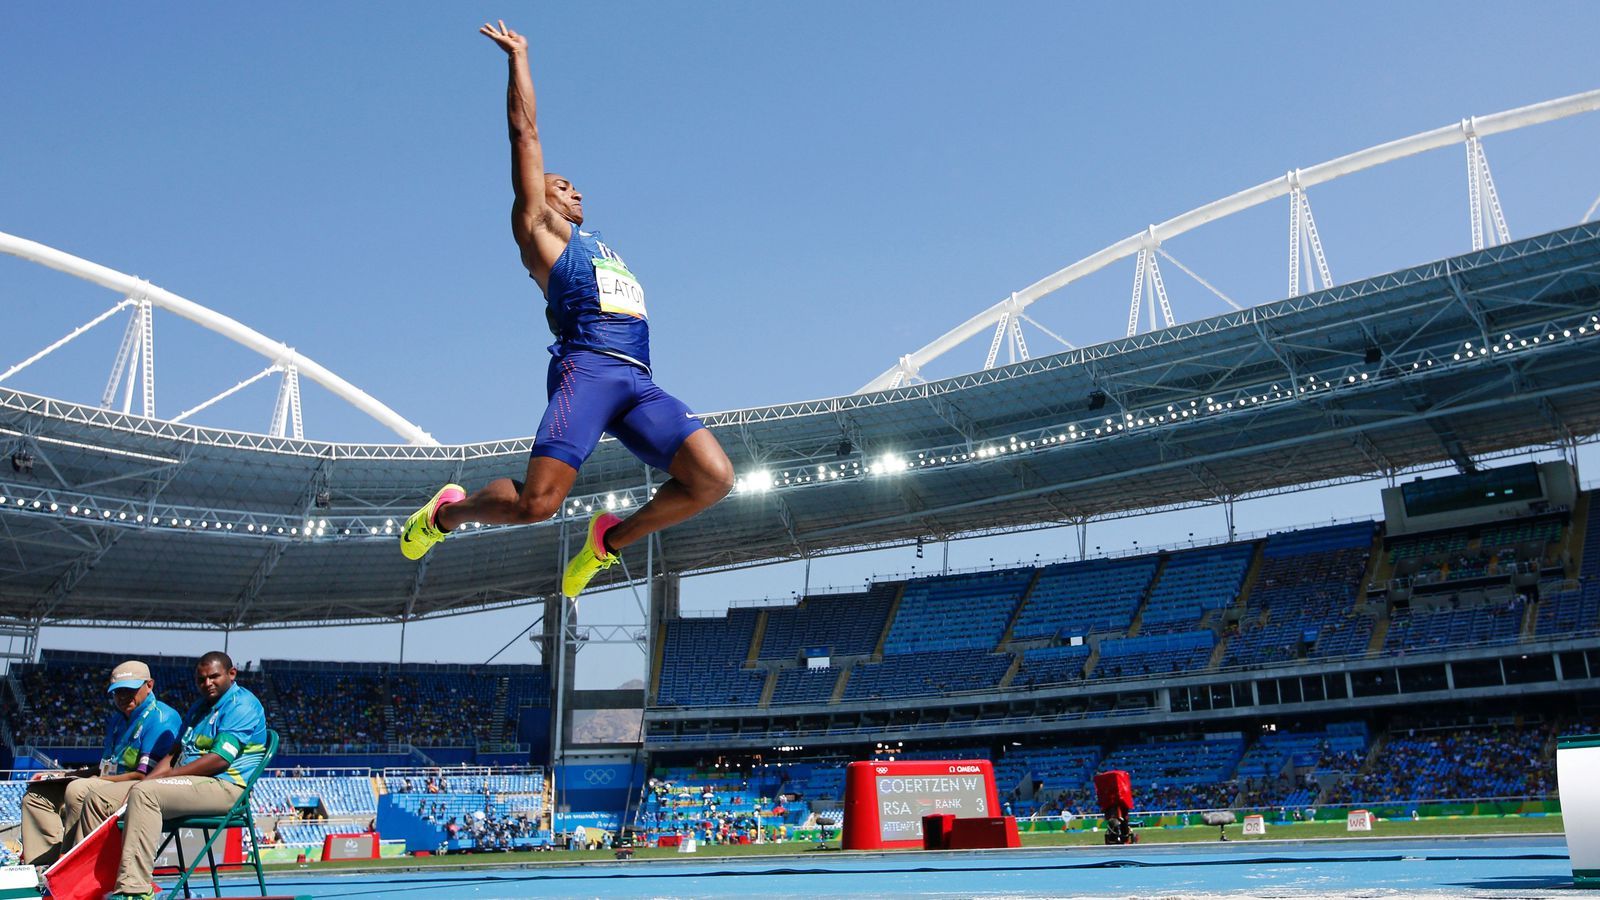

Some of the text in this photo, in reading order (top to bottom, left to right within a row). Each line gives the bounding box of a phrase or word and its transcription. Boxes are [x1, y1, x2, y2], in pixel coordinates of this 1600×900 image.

[879, 777, 977, 794] COERTZEN W
[883, 797, 985, 815] RSA RANK 3
[883, 820, 923, 836] ATTEMPT 1
[1246, 823, 1260, 832] OR
[1350, 818, 1366, 828] WR
